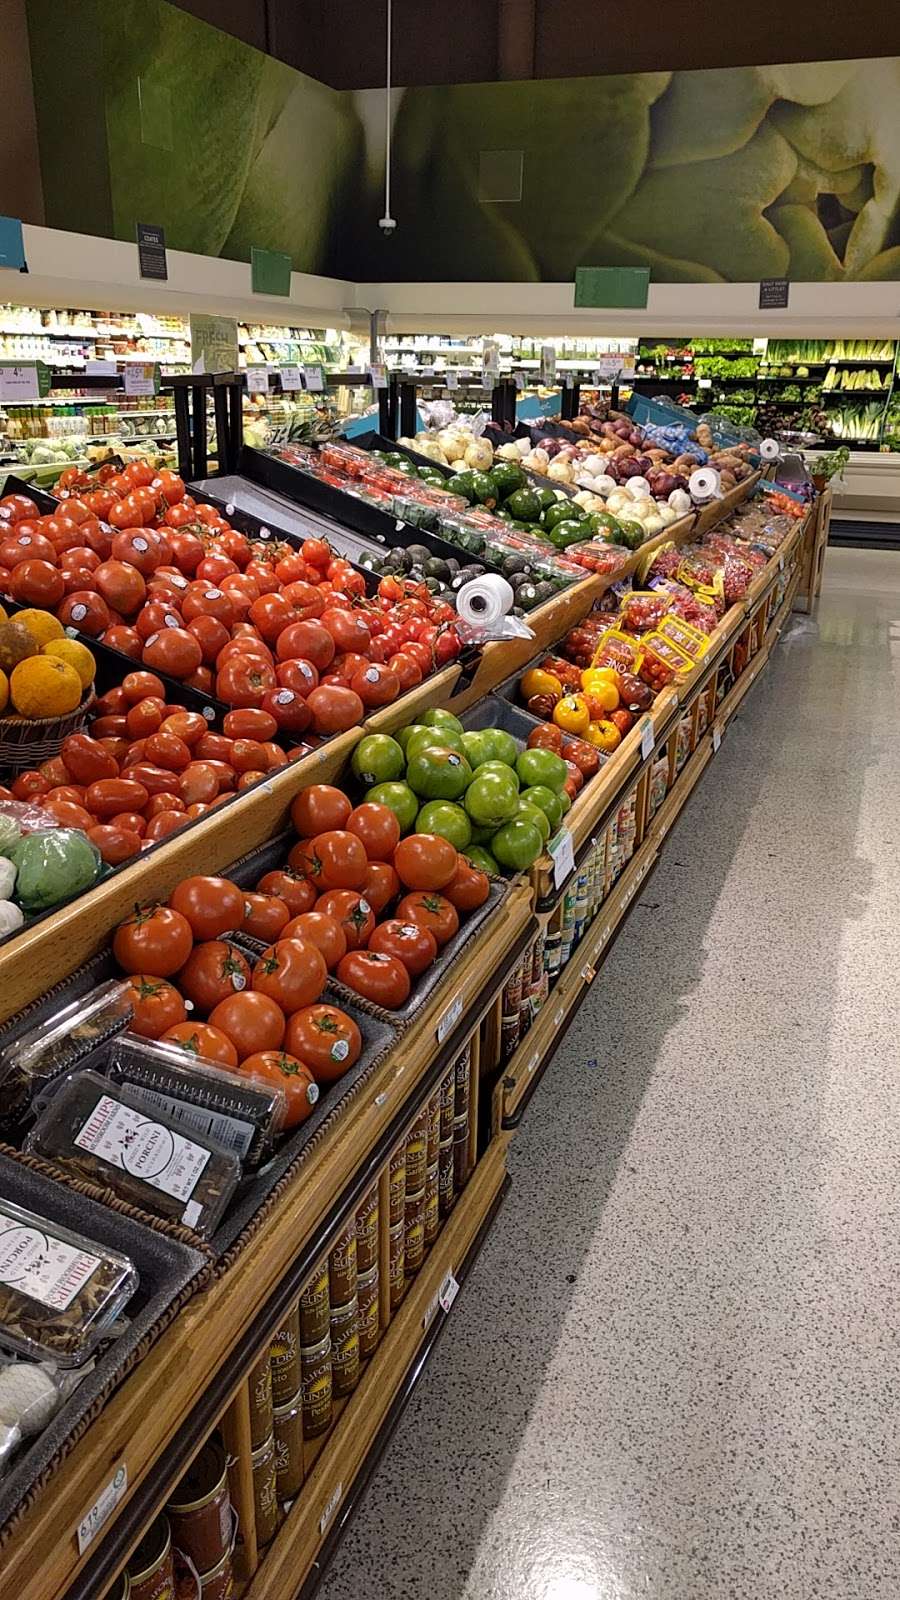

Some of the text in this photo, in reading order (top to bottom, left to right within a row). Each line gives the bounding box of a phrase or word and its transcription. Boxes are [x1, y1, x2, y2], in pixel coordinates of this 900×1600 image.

[604, 656, 627, 674] ONE
[79, 1098, 114, 1149] PHILLIPS
[135, 1130, 161, 1169] PORCINI
[0, 1235, 33, 1274] PORCINI
[50, 1254, 96, 1306] PHILLIPS
